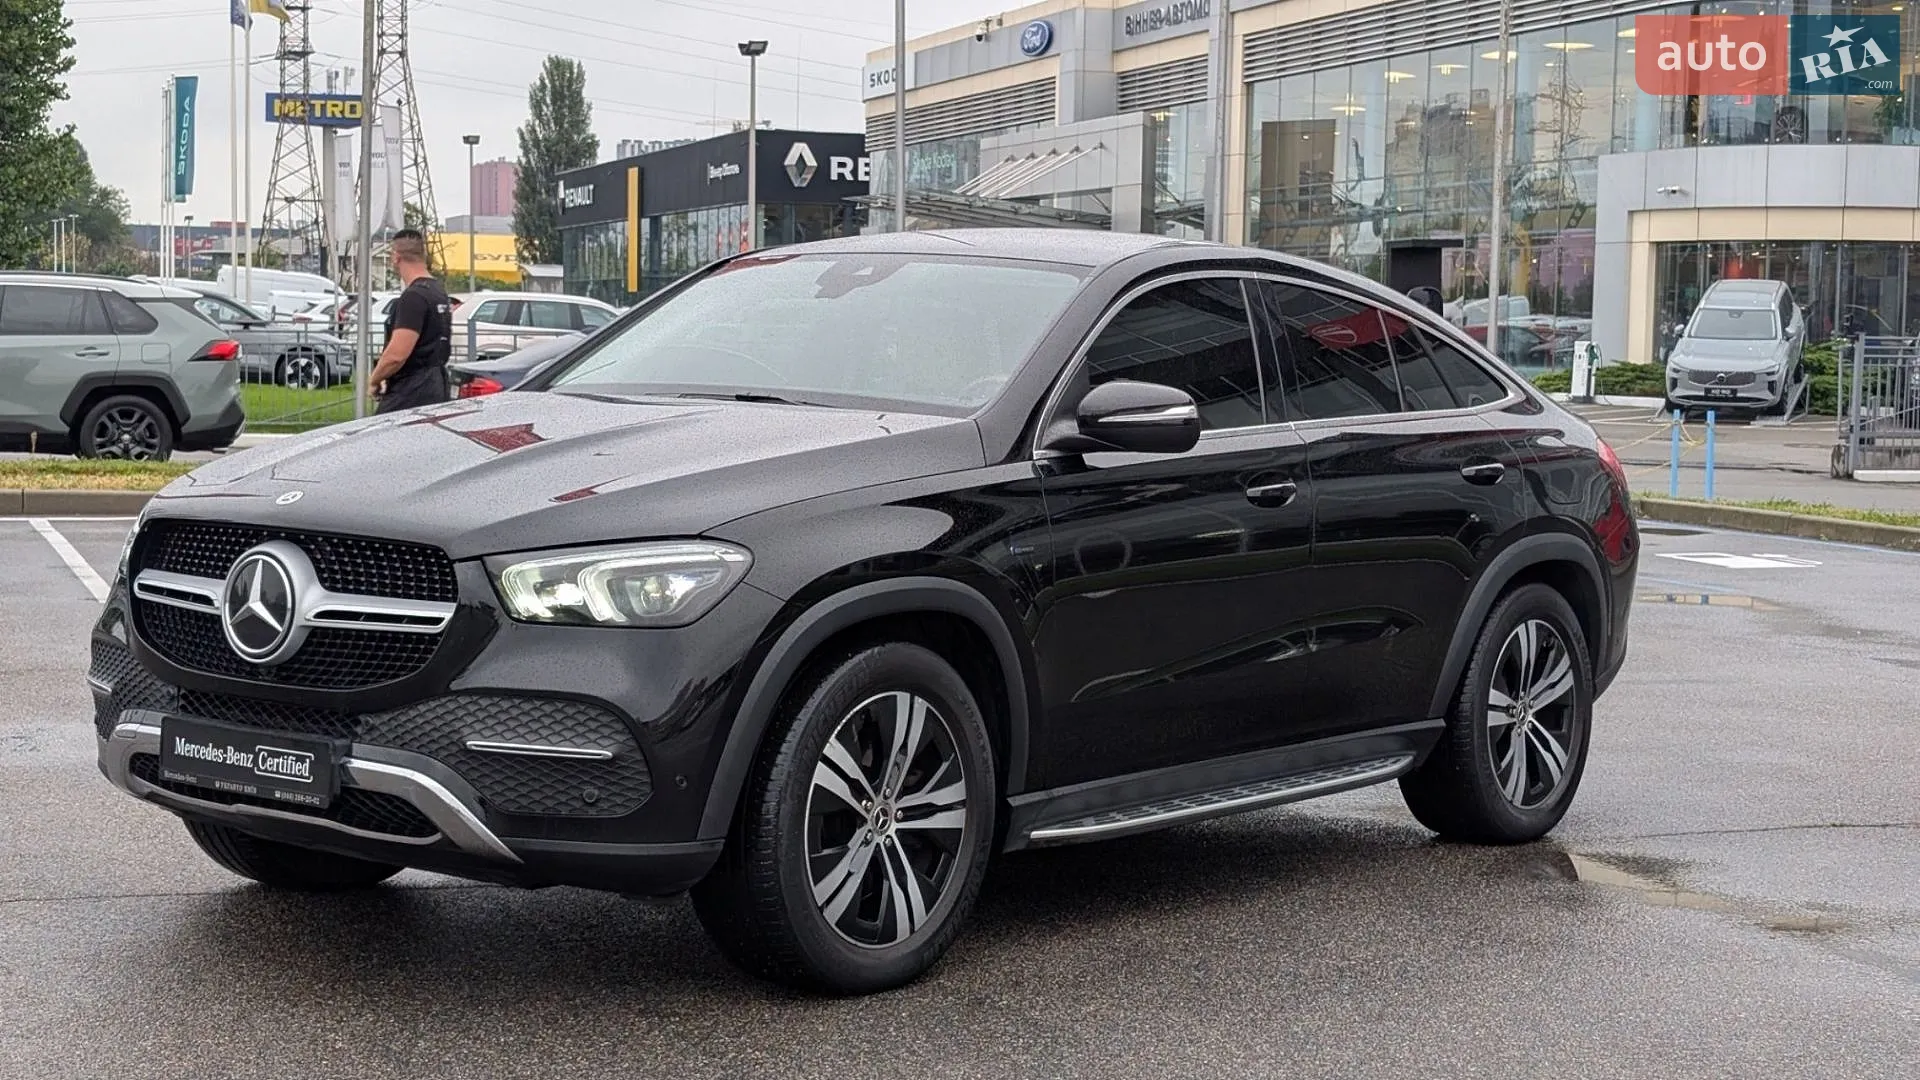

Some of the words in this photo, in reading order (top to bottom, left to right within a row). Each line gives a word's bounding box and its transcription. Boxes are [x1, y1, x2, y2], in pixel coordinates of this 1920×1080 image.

[869, 68, 897, 88] SKOD
[274, 99, 363, 119] METRO
[565, 184, 594, 208] RENAULT
[174, 736, 254, 768] Mercedes-Benz
[258, 751, 310, 777] Certified
